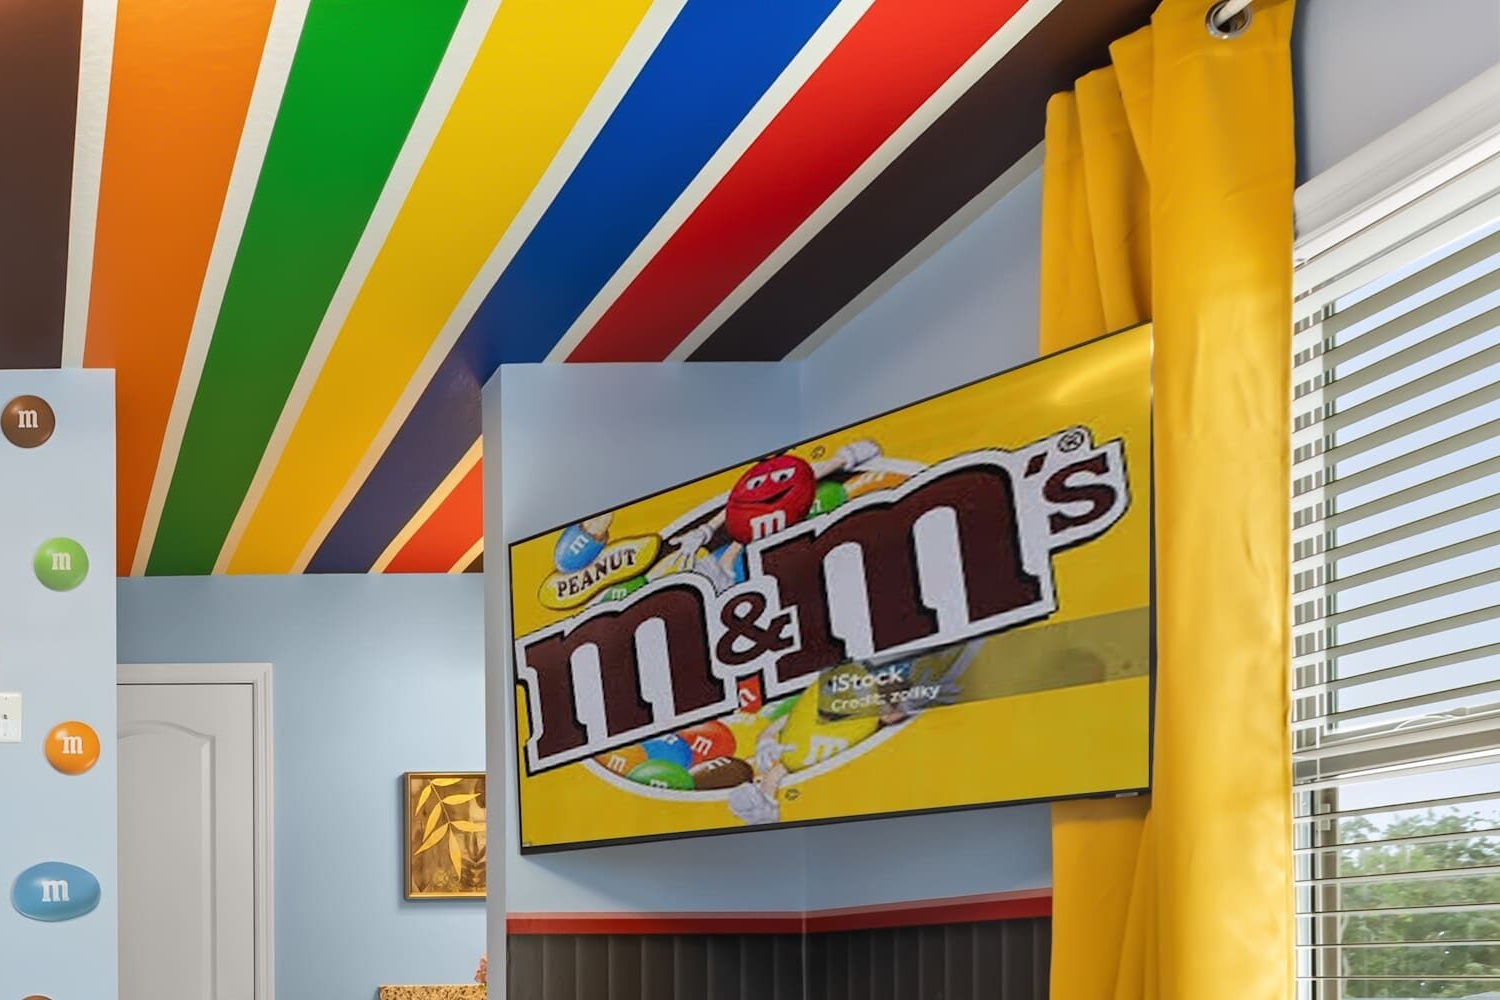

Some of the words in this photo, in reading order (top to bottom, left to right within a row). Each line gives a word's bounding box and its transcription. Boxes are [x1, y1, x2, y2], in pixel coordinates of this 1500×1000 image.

[18, 409, 38, 429] m
[750, 510, 787, 540] m
[51, 551, 72, 571] m
[556, 548, 637, 598] PEANUT
[831, 666, 905, 694] iStock
[62, 735, 84, 754] m
[691, 735, 713, 756] m
[607, 754, 626, 772] m
[41, 879, 70, 903] m
